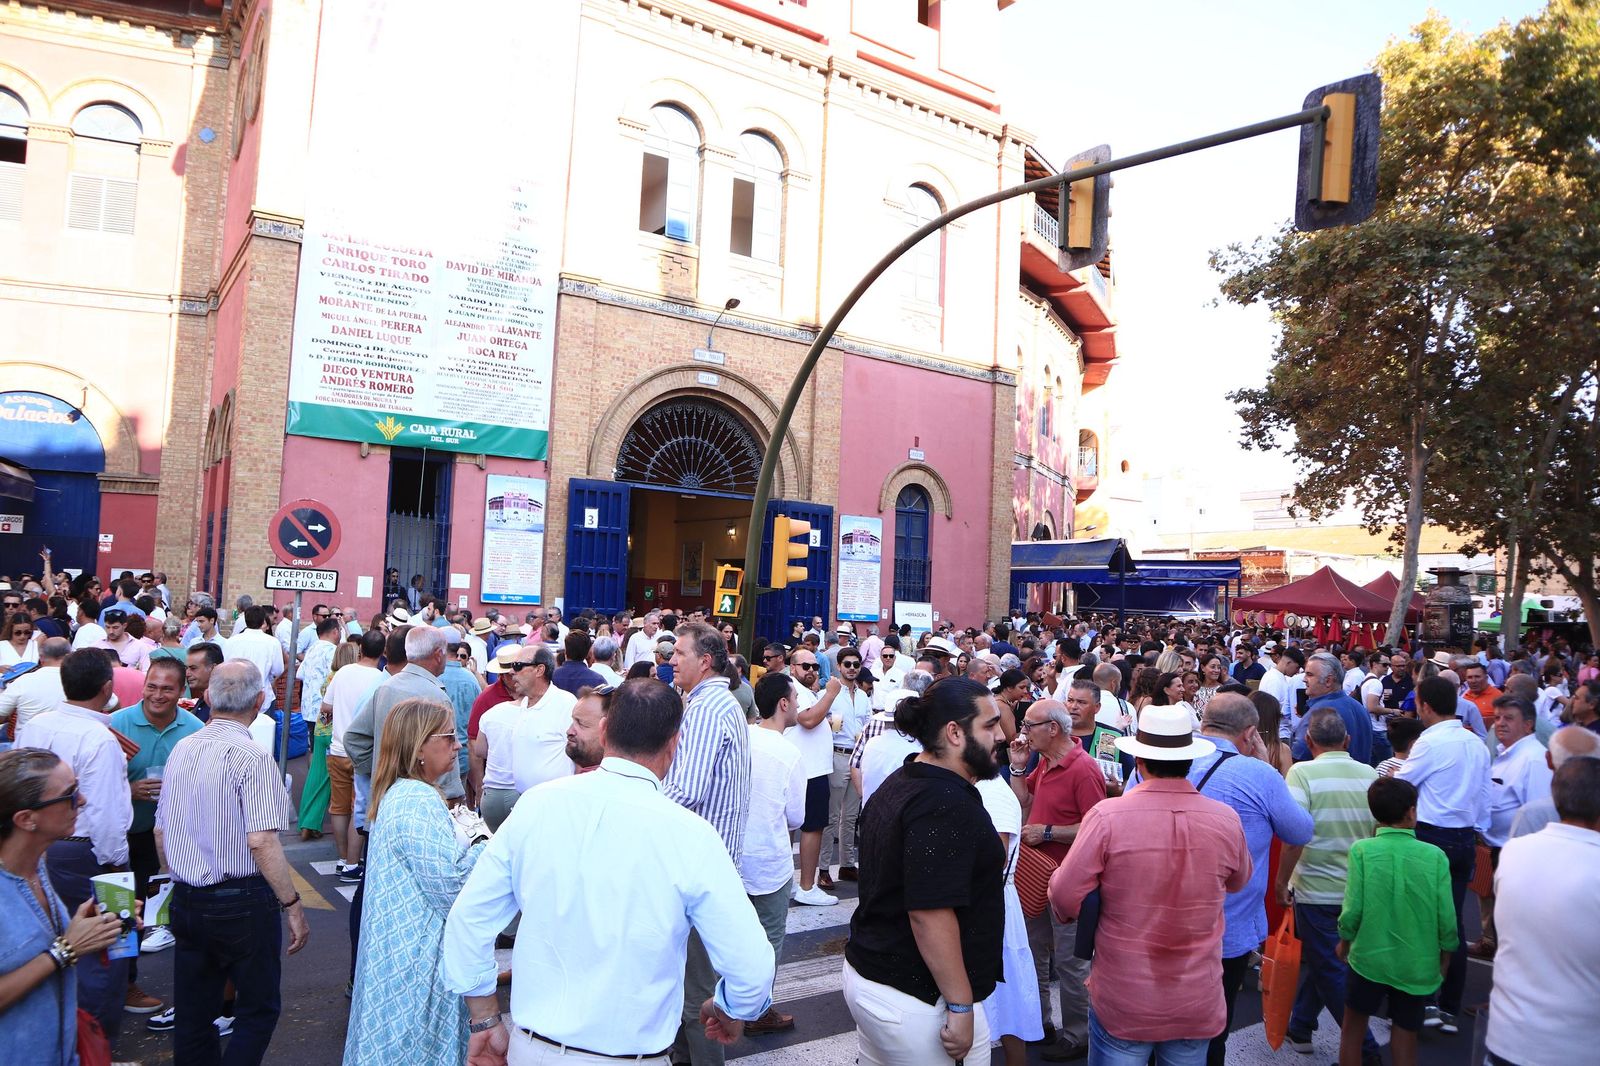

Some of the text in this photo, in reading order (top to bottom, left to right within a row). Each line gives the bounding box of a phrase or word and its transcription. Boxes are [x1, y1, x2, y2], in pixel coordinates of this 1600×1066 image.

[327, 243, 427, 270] ENRIQUE TORO
[322, 256, 430, 283] CARLOS TIRADO
[445, 260, 543, 287] DAVID DE MIRANDA
[320, 271, 364, 284] VIERNES
[391, 284, 431, 294] AGOSTO
[346, 290, 409, 306] ZALDUENDO
[387, 289, 412, 299] Toros
[318, 295, 373, 312] MORANTE
[388, 309, 397, 317] LA
[399, 310, 427, 321] PUEBLA
[454, 310, 475, 318] JUAN
[321, 312, 350, 322] MIGUEL
[380, 319, 423, 334] PERERA
[444, 319, 542, 340] ALEJANDRO TALAVANTE
[331, 324, 412, 346] DANIEL LUQUE
[456, 332, 528, 351] JUAN ORTEGA
[311, 337, 362, 349] DOMINGO
[390, 348, 428, 359] AGOSTO
[323, 347, 361, 357] Corrida
[467, 346, 518, 362] ROCA REY
[322, 363, 414, 383] DIEGO VENTURA
[478, 360, 507, 369] ONLINE
[320, 375, 415, 395] ANDRÉS ROMERO
[409, 423, 477, 440] CAJA RURAL
[587, 514, 594, 526] 3
[812, 534, 818, 545] 3
[270, 570, 334, 581] EXCEPTO BUS
[276, 579, 327, 588] E.M.T.U.S.A.
